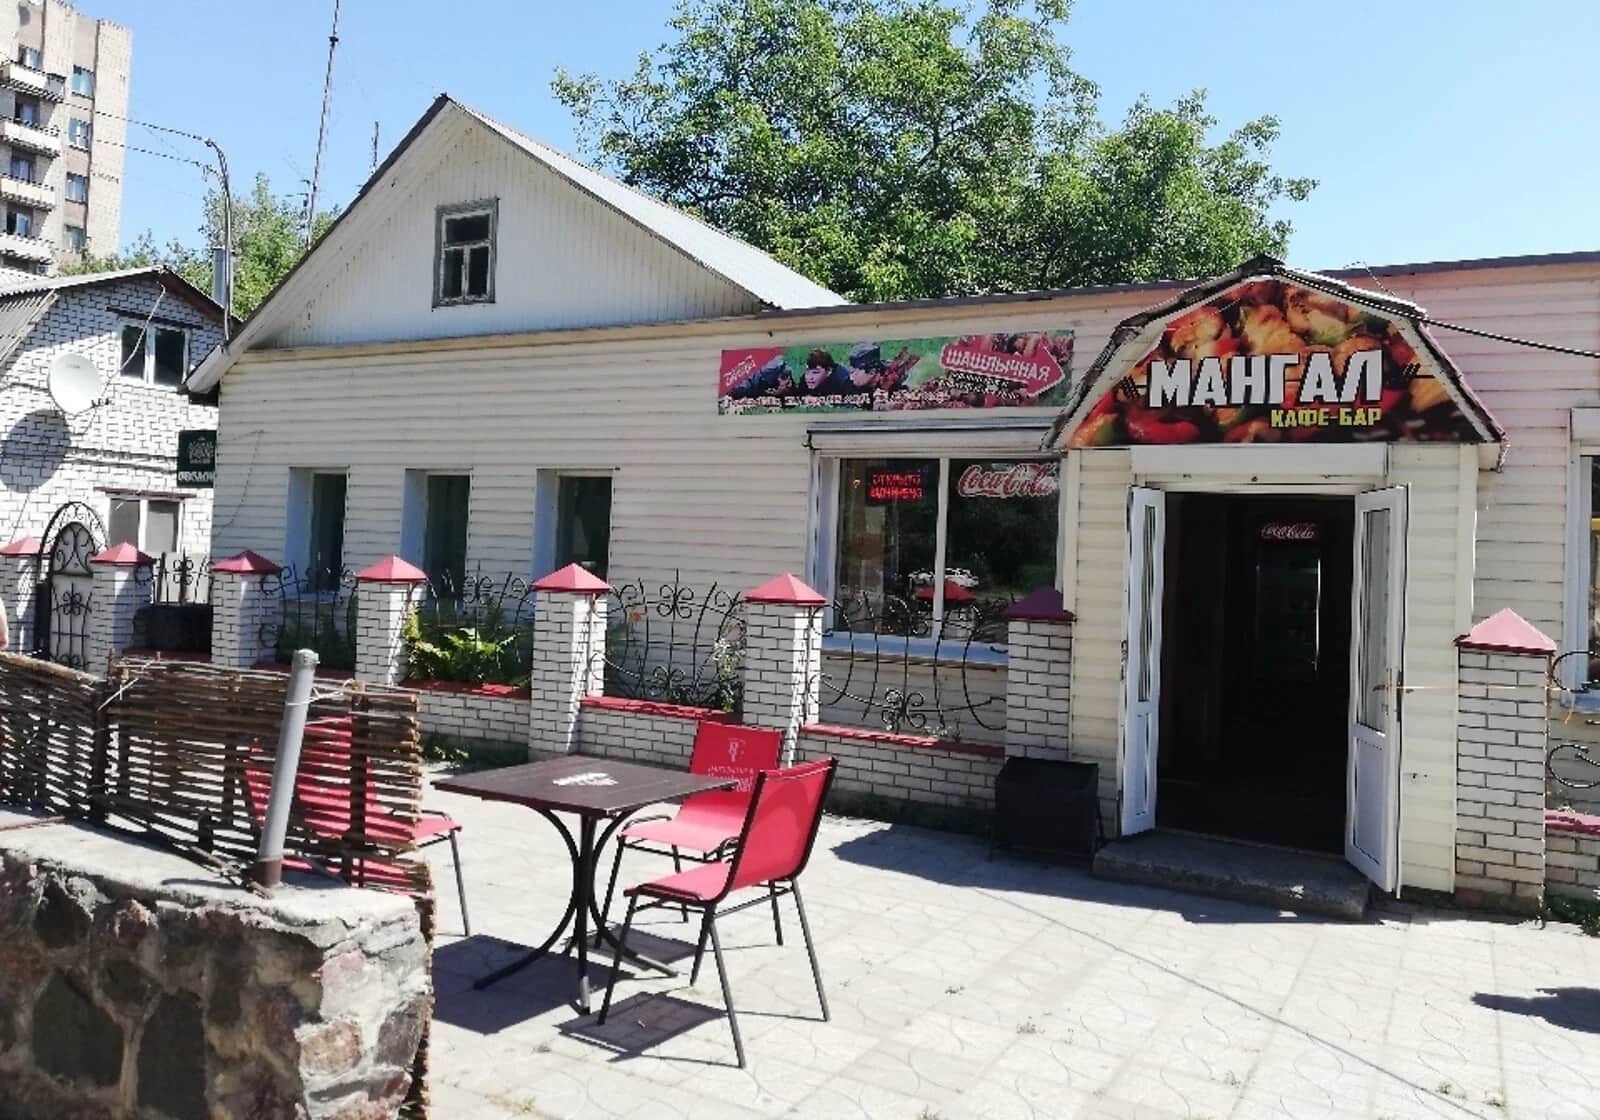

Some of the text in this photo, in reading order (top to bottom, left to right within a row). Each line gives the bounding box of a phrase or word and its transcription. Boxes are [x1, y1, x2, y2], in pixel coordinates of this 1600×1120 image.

[945, 349, 1051, 382] ШАШЛЫЧНАЯ
[1149, 350, 1383, 408] МАНГАЛ
[1270, 407, 1382, 428] КАФЕ-БАР
